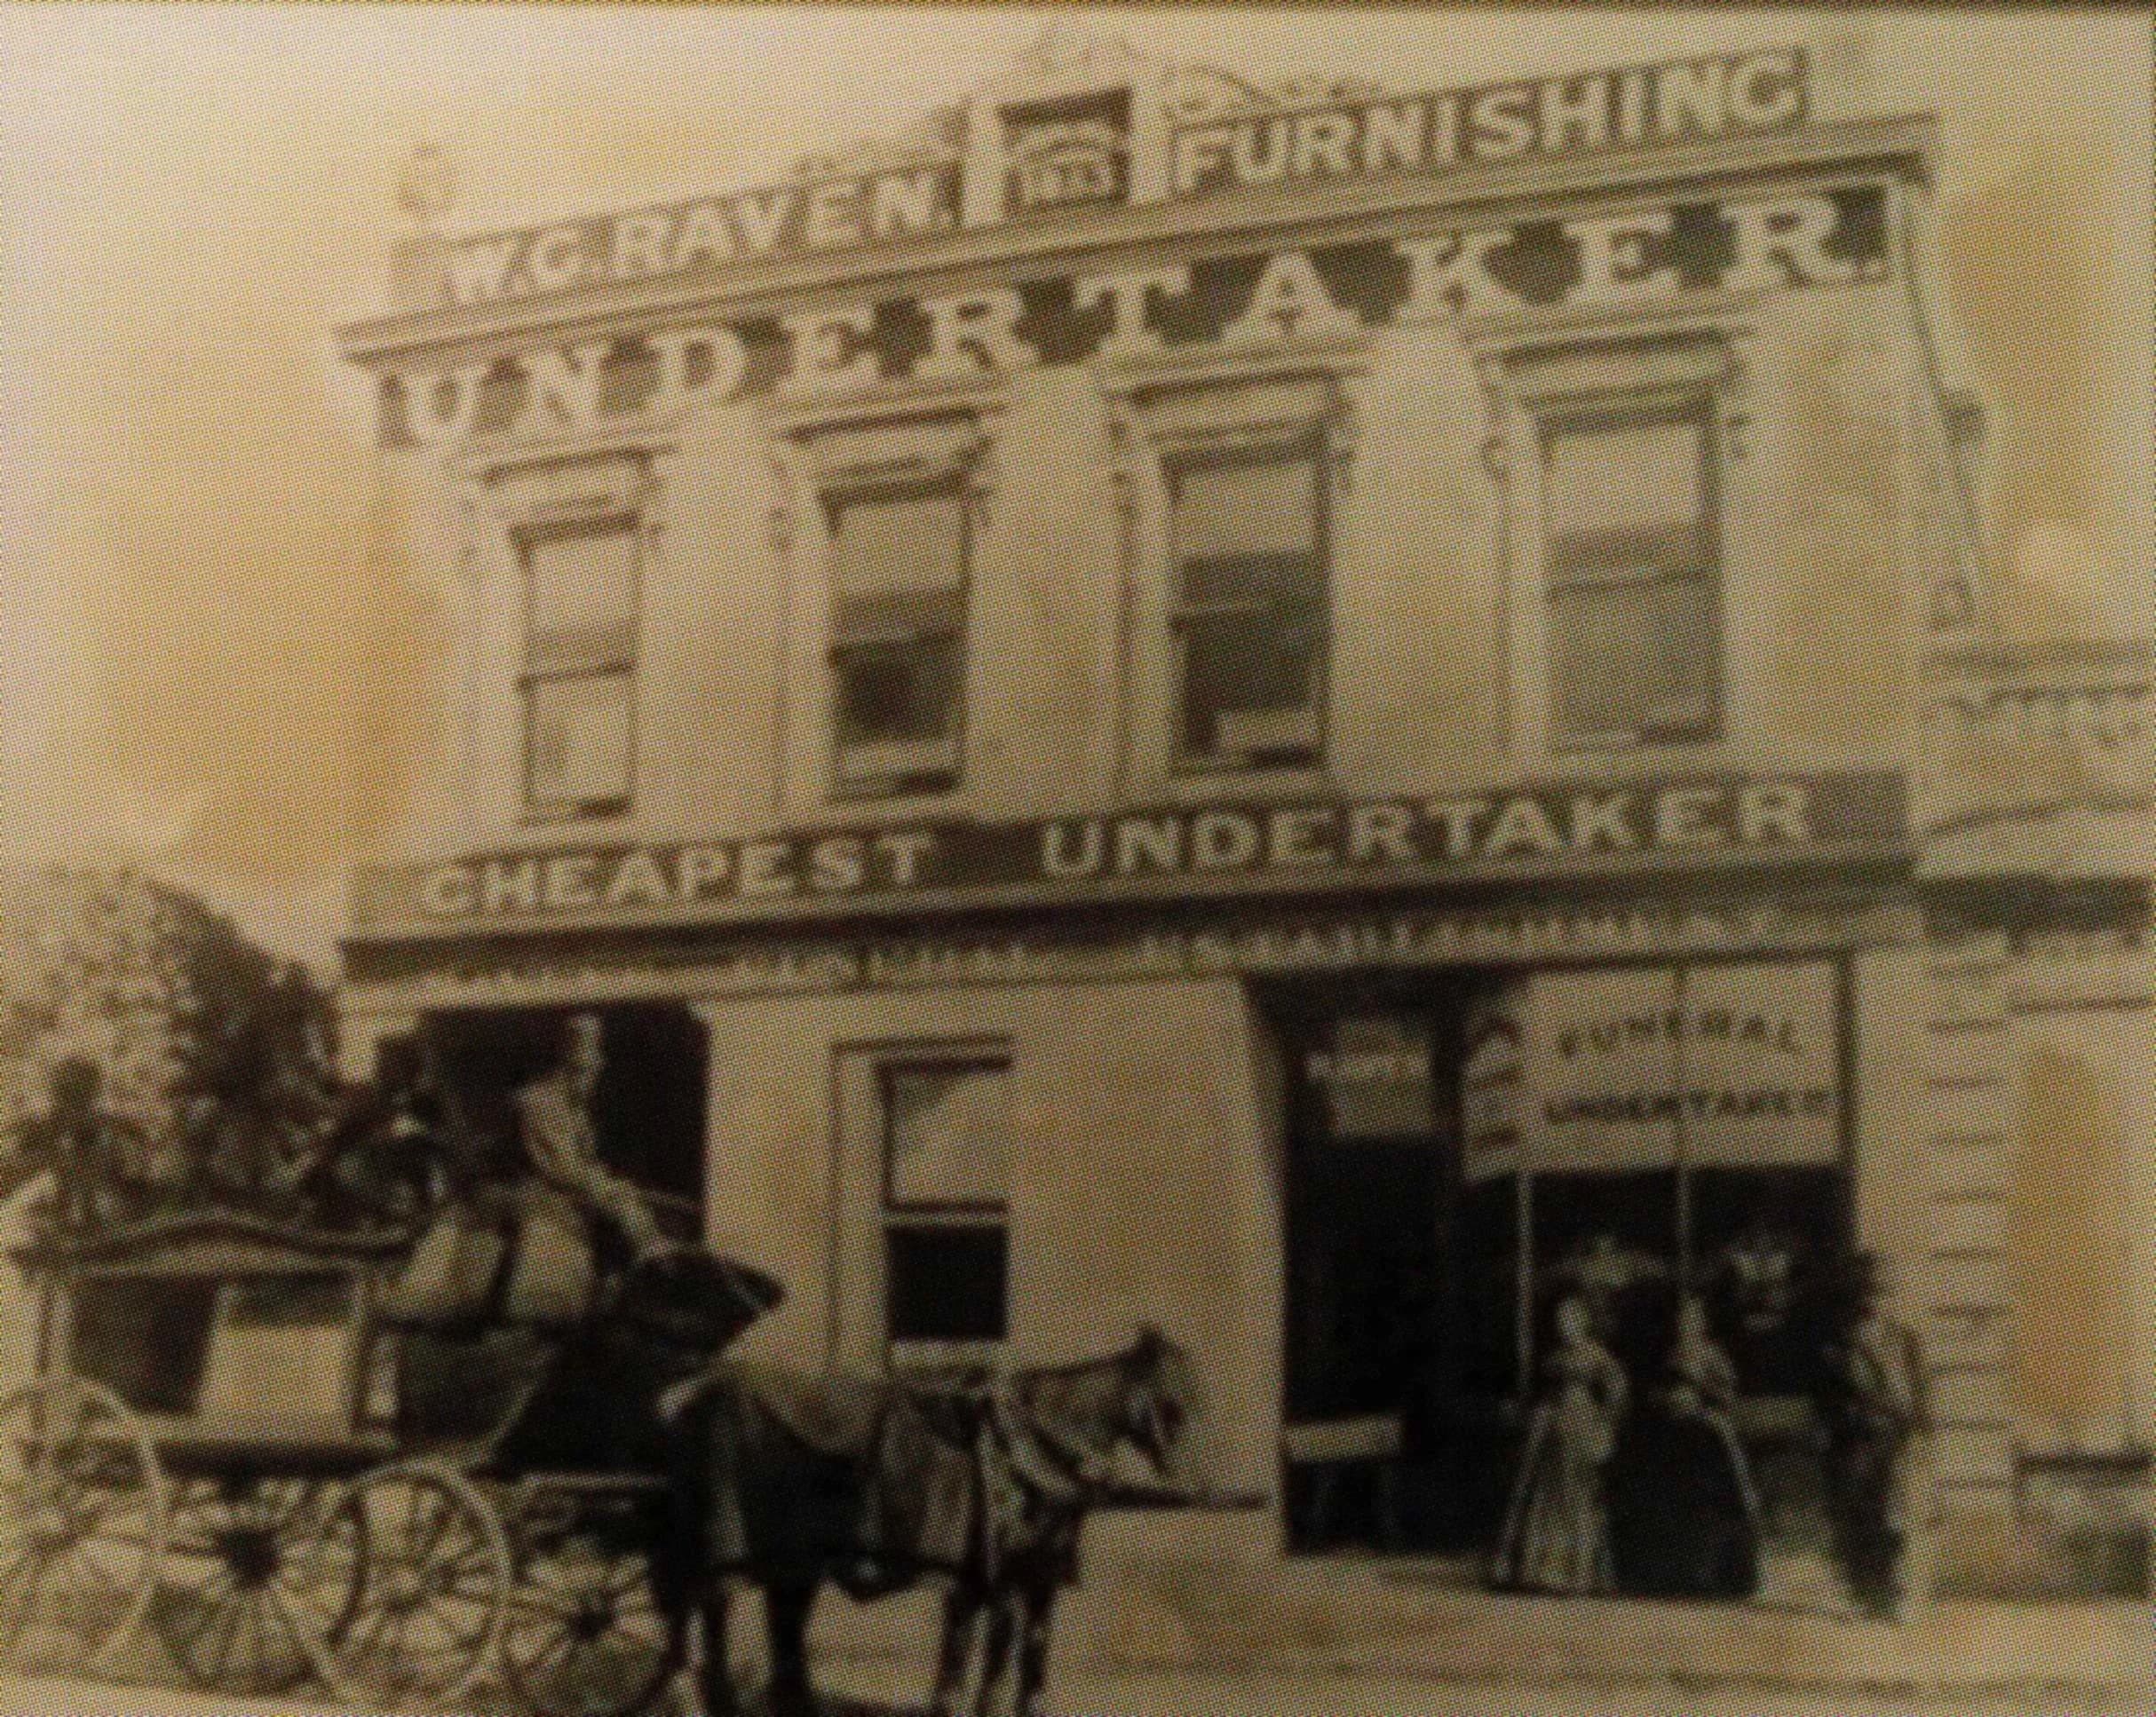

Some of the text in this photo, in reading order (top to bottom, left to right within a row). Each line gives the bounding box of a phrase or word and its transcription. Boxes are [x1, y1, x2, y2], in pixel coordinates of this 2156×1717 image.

[1176, 53, 1802, 194] FURNISHING
[422, 783, 1811, 915] CHEAPEST UNDERTAKER
